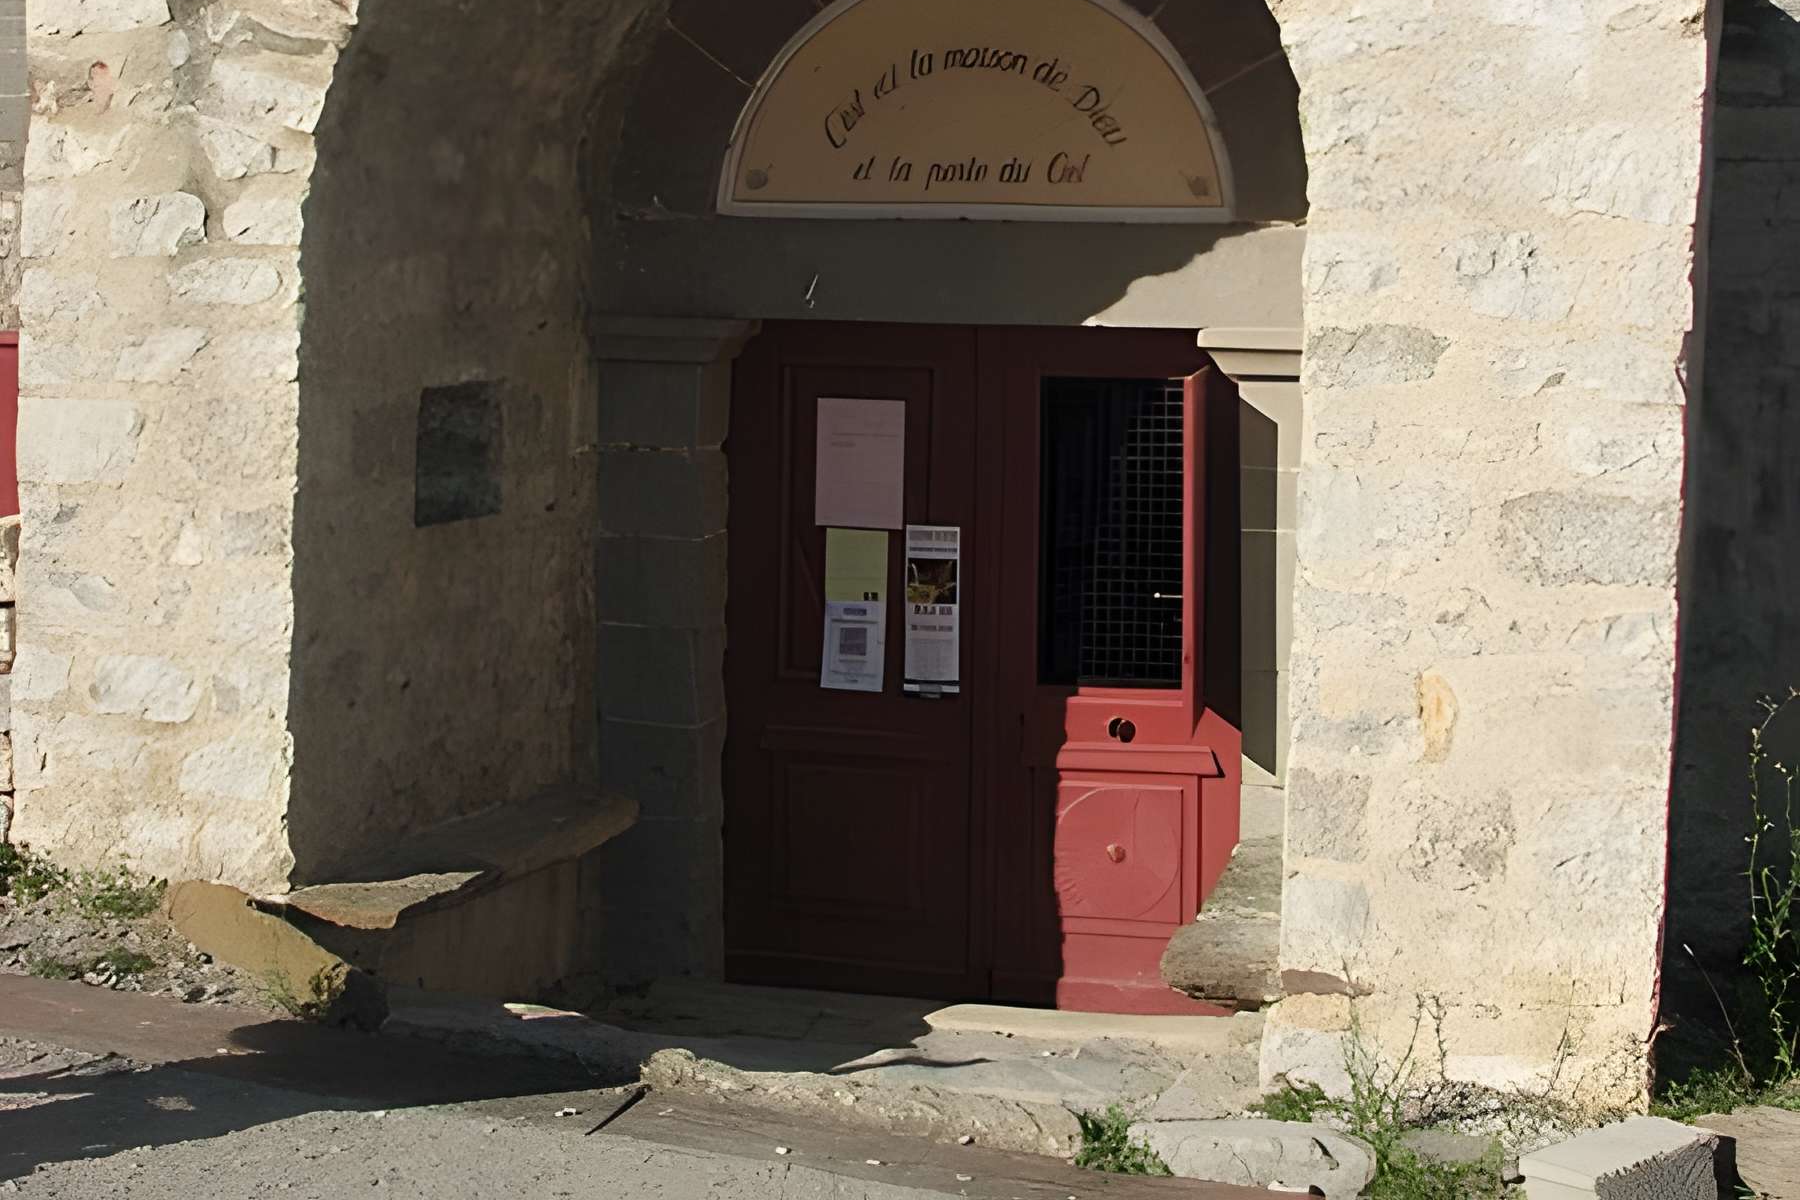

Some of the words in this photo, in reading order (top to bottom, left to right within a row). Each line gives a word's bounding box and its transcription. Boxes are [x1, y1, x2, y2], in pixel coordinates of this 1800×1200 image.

[911, 47, 933, 80] la
[944, 47, 1028, 75] maison
[1033, 56, 1068, 93] de
[1072, 85, 1128, 146] Dieu
[999, 157, 1032, 183] du
